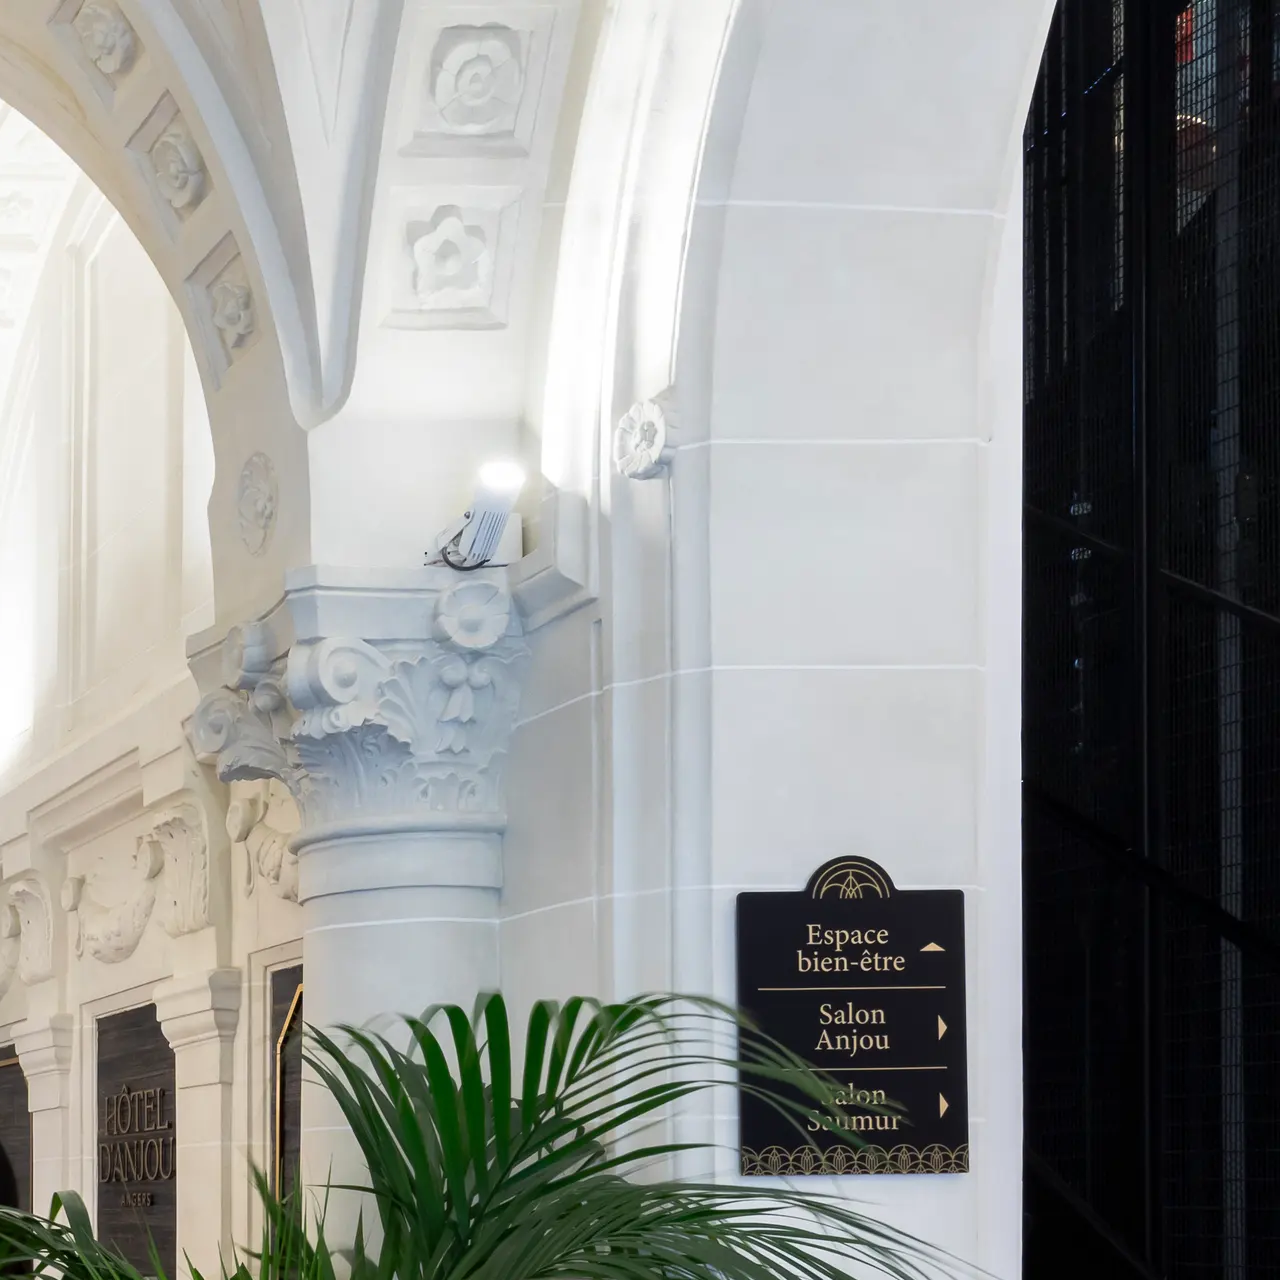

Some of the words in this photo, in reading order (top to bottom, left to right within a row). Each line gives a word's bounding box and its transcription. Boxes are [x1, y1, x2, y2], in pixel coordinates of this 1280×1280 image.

[806, 923, 889, 952] Espace
[796, 949, 906, 973] bien-être
[819, 1001, 886, 1025] Salon
[814, 1028, 890, 1057] Anjou
[821, 1082, 887, 1106] alon
[104, 1083, 169, 1136] HÔTEL
[99, 1136, 174, 1183] D'ANJOU
[121, 1192, 152, 1207] ANGERS
